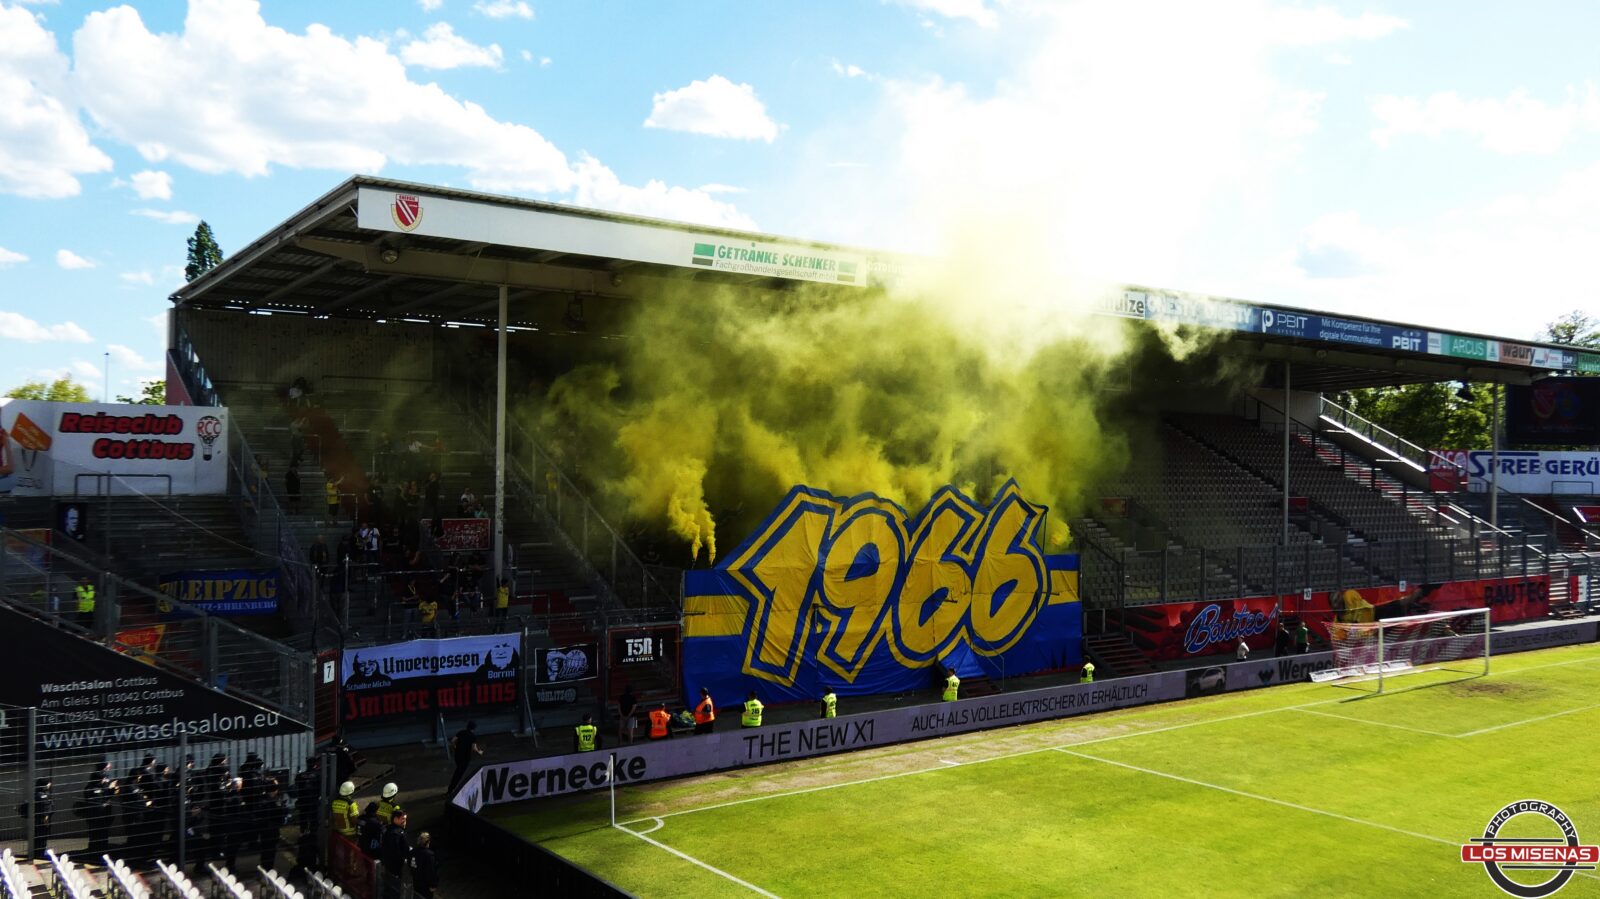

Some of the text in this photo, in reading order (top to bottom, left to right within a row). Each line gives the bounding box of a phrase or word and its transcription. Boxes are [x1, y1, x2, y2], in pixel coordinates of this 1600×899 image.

[717, 242, 836, 270] GETRÄNKE SCHENKER
[1277, 314, 1308, 329] PBIT
[1322, 318, 1331, 328] Mit
[1331, 319, 1362, 331] Kompetenz
[1392, 336, 1421, 351] PBIT
[1452, 339, 1483, 356] ARCUS
[1503, 344, 1535, 365] waury
[59, 412, 183, 434] Reiseclub
[198, 420, 222, 434] RCC
[92, 438, 194, 460] Cottbus
[1470, 452, 1540, 477] SPREE
[182, 578, 277, 600] LEIPZIG
[727, 487, 1047, 688] 1966
[1485, 582, 1546, 607] BAUTEC
[1184, 604, 1279, 653] Bautec
[384, 653, 480, 674] Unvergessen
[40, 676, 158, 693] WaschSalon Cottbus
[437, 679, 472, 708] mit
[476, 681, 517, 704] uns
[40, 699, 60, 708] Am
[62, 696, 90, 707] Gleis
[92, 694, 99, 704] 5
[107, 692, 139, 703] 03042
[142, 689, 184, 700] Cottbus
[146, 704, 165, 715] 251
[911, 713, 945, 732] AUCH
[947, 709, 969, 727] ALS
[970, 694, 1075, 723] VOLLELEKTRISCHER
[1091, 684, 1148, 706] ERHÄLTLICH
[43, 712, 280, 749] www.waschsalon.eu
[743, 718, 875, 759] THE NEW X1
[481, 752, 646, 802] Wernecke
